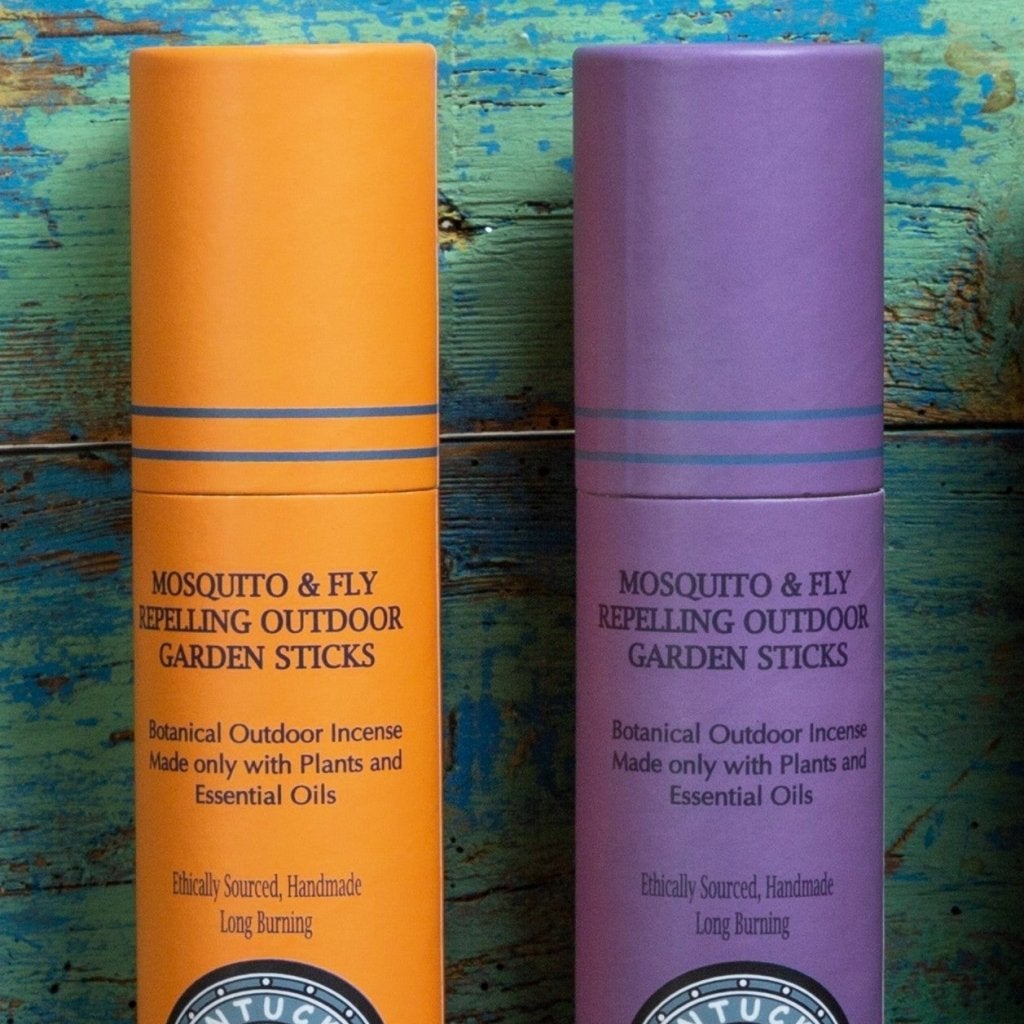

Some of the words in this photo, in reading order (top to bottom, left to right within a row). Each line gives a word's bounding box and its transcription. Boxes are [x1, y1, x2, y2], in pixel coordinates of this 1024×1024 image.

[152, 570, 288, 601] MOSQUITO
[298, 573, 320, 597] &
[328, 571, 378, 596] FLY
[619, 570, 772, 601] MOSQUITO
[781, 572, 802, 597] &
[808, 570, 851, 596] FLY
[139, 605, 252, 634] REPELLING
[261, 606, 403, 634] OUTDOOR
[598, 603, 735, 634] REPELLING
[743, 604, 869, 634] OUTDOOR
[159, 642, 265, 670] GARDEN
[275, 643, 375, 670] STICKS
[628, 642, 748, 670] GARDEN
[758, 642, 848, 670] STICKS
[149, 719, 221, 743] Botanical
[229, 722, 324, 744] Outdoor
[332, 723, 402, 742] Incense
[149, 751, 188, 772] Made
[194, 753, 237, 780] only
[243, 753, 291, 774] with
[301, 753, 363, 774] Plants
[370, 749, 402, 771] and
[196, 784, 281, 805] Essential
[290, 783, 336, 805] Oils
